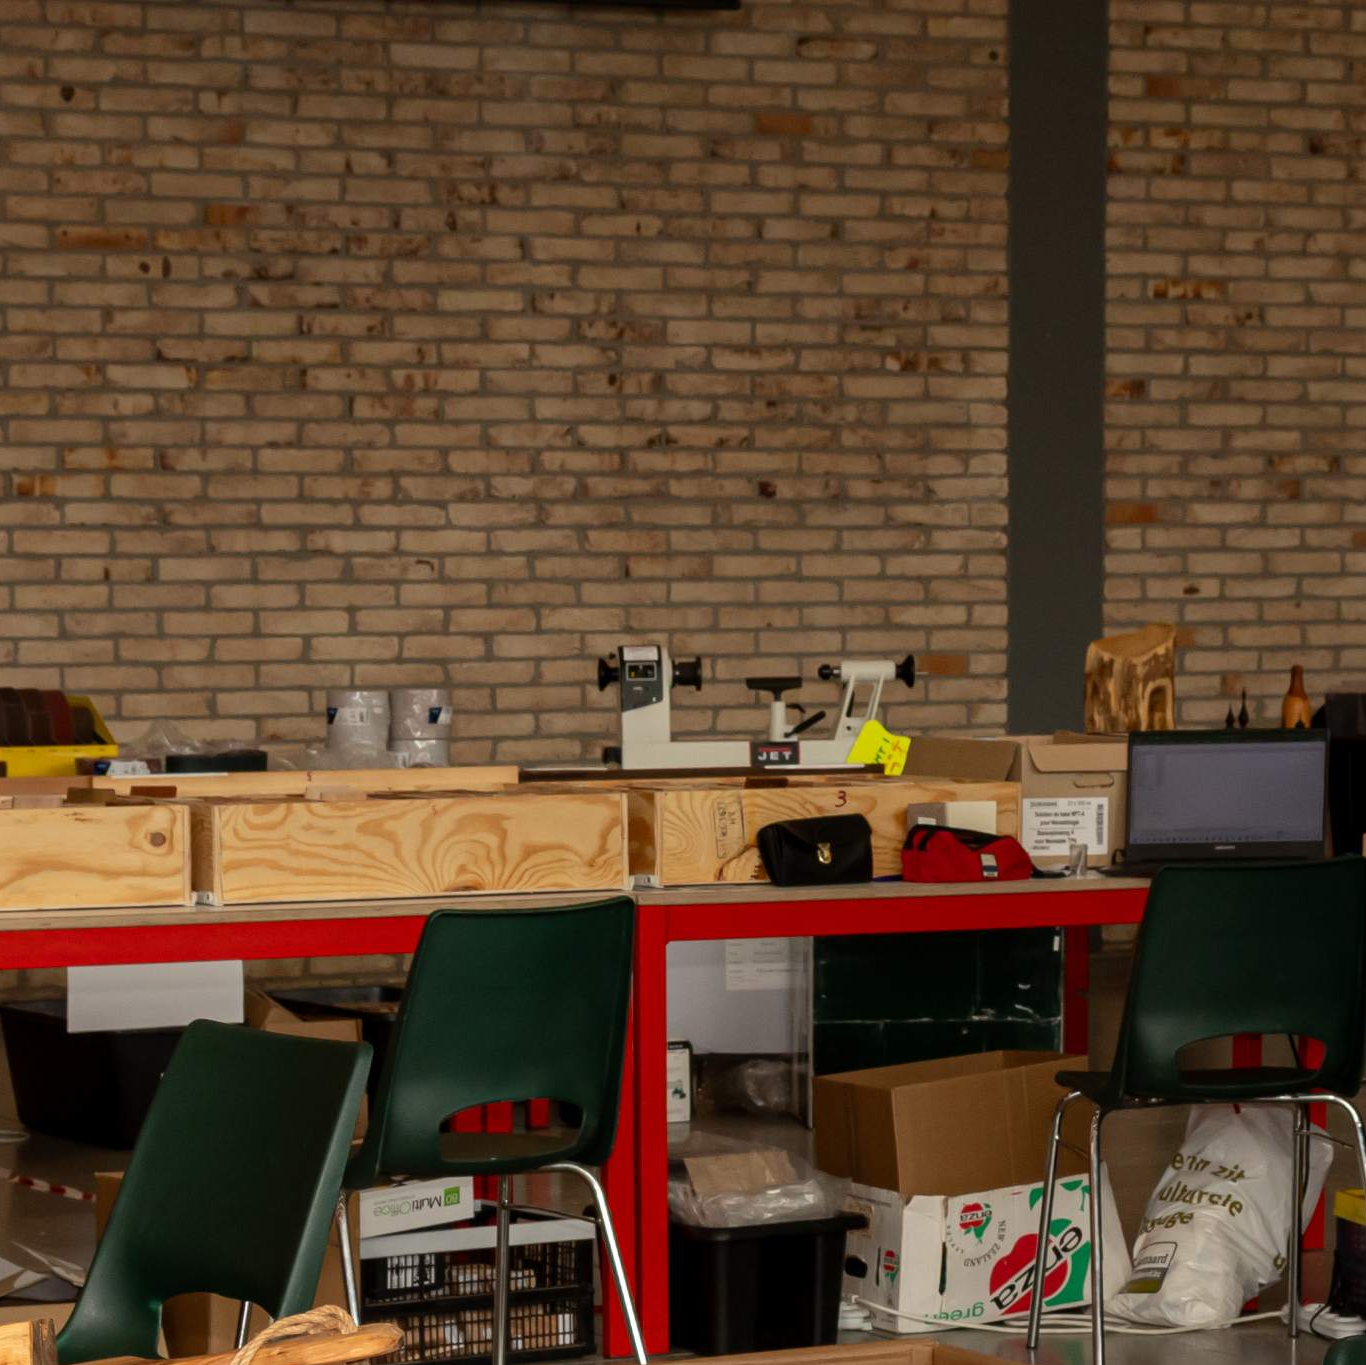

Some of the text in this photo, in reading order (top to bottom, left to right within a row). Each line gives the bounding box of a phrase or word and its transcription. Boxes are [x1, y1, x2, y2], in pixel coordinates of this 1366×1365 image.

[757, 751, 793, 761] JET
[835, 790, 848, 808] 3
[960, 1209, 993, 1222] enza
[963, 1219, 1007, 1268] NEW ZEALAND
[924, 1301, 985, 1321] gree
